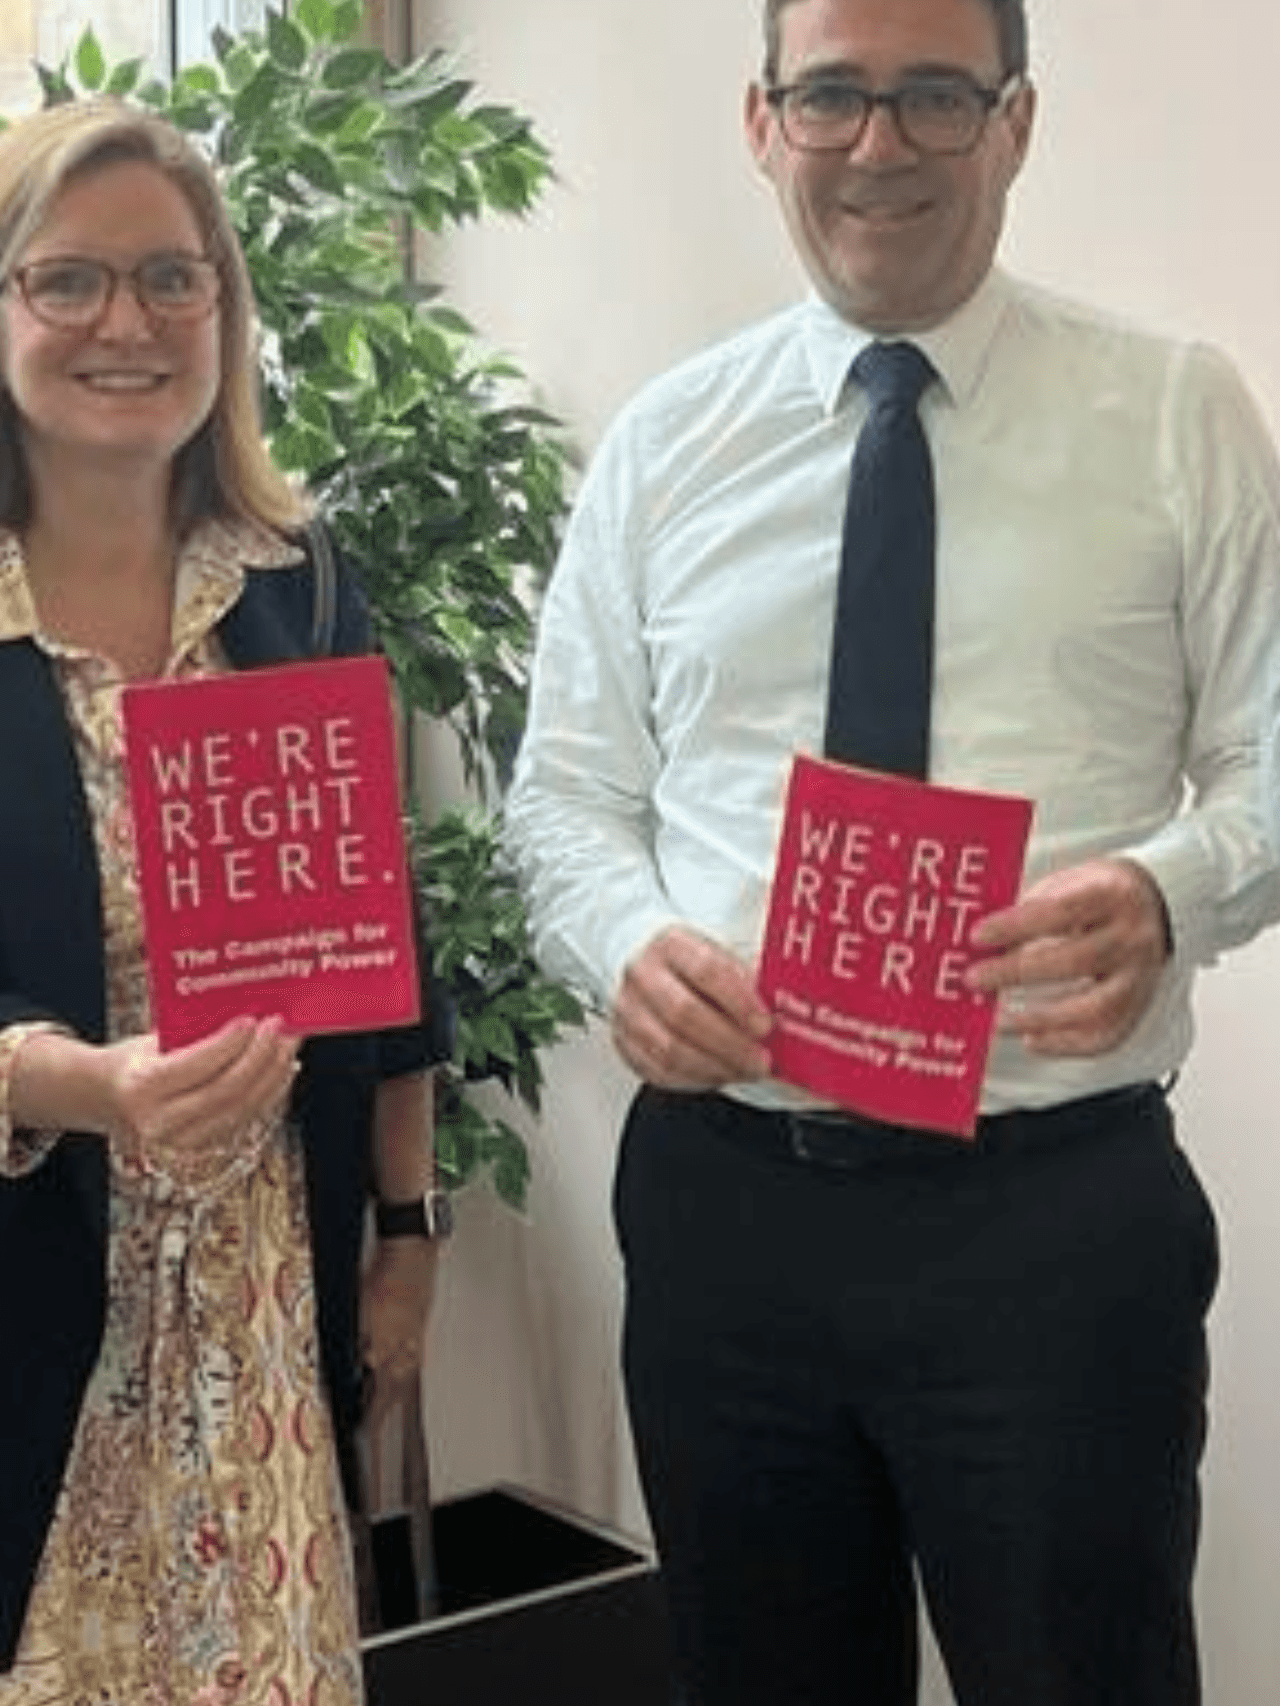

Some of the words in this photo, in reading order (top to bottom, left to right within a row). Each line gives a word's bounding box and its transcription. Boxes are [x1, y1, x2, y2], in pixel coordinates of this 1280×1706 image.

[151, 718, 359, 793] WE'RE
[161, 776, 362, 852] RIGHT
[167, 834, 395, 911] HERE.
[801, 810, 990, 895] WE'RE
[793, 866, 982, 945] RIGHT
[172, 948, 218, 970] The
[224, 926, 348, 961] Campaign
[353, 922, 389, 943] for
[175, 959, 315, 996] Community
[321, 948, 398, 972] Power
[783, 915, 985, 1006] HERE.
[815, 1004, 928, 1050] Campaign
[933, 1032, 967, 1054] for
[894, 1051, 968, 1078] Power
